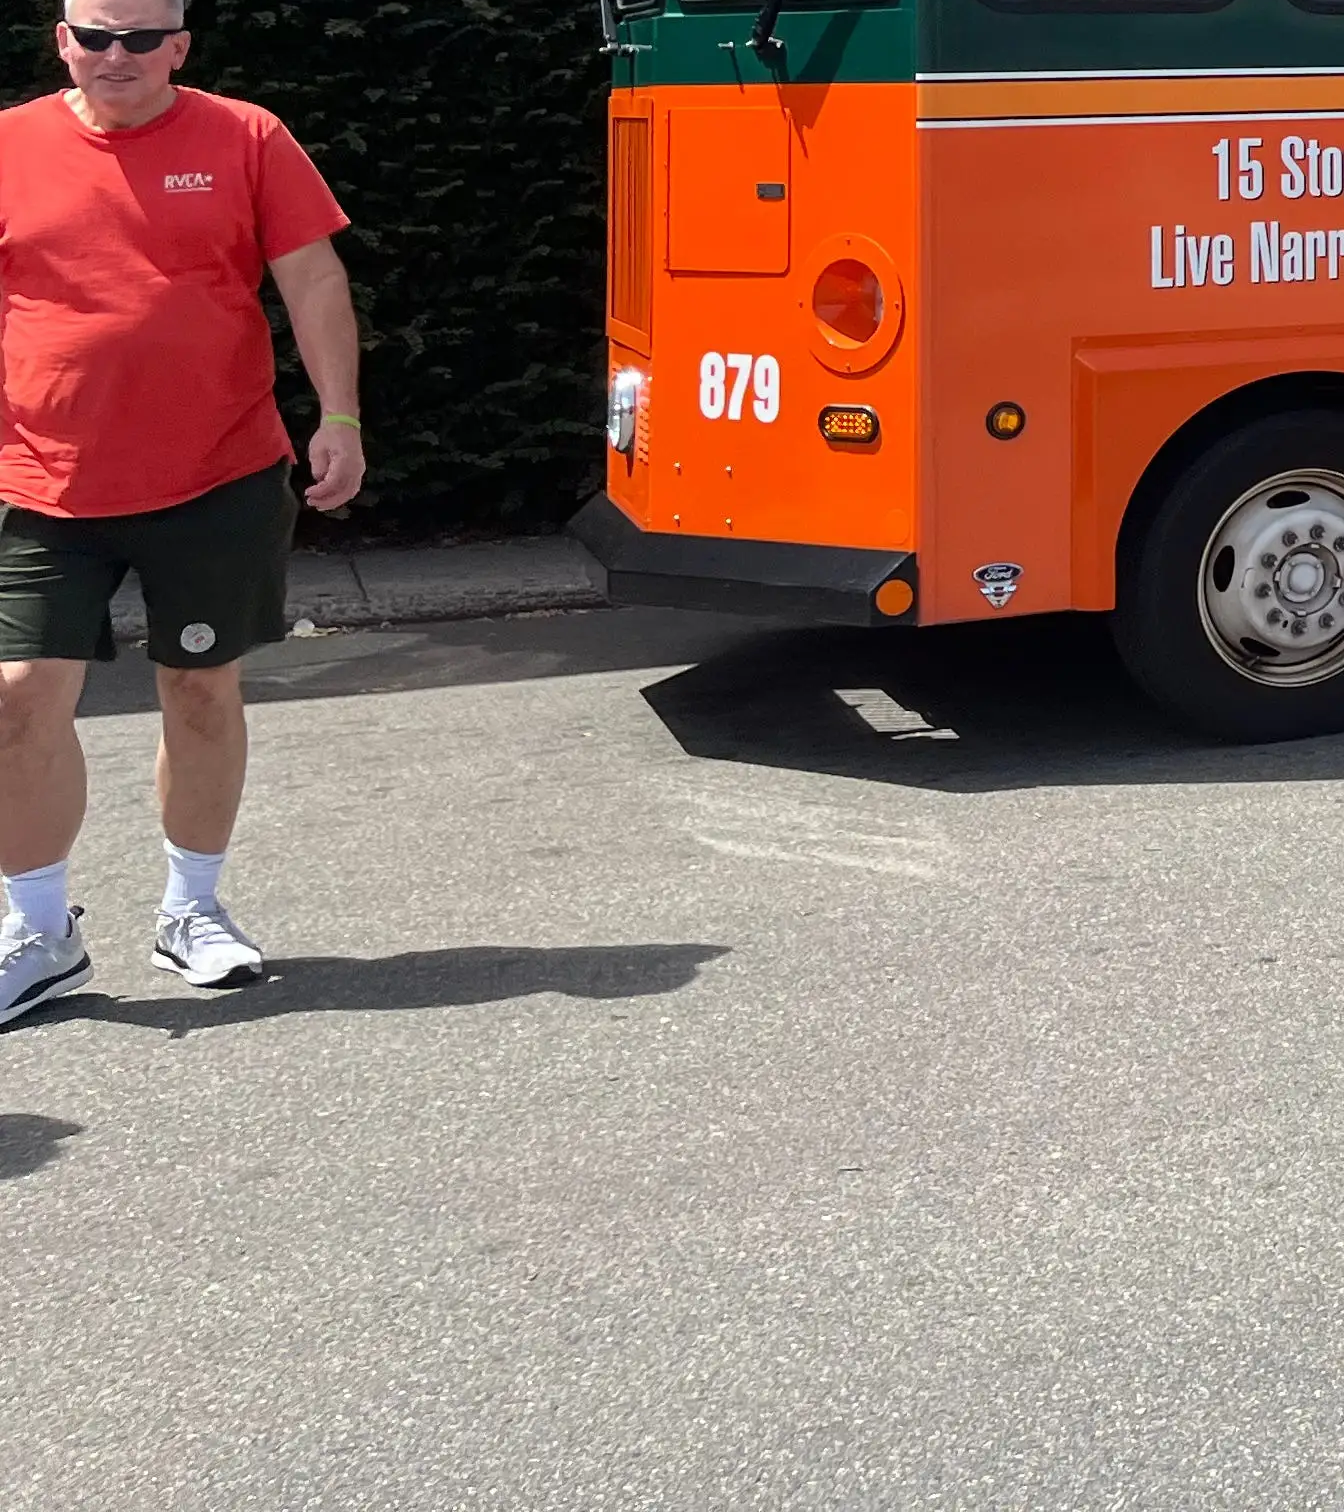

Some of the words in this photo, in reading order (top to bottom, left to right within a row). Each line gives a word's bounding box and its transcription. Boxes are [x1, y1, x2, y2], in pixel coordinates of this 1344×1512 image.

[1212, 137, 1264, 200] 15
[1151, 224, 1235, 289] Live
[699, 351, 781, 424] 879
